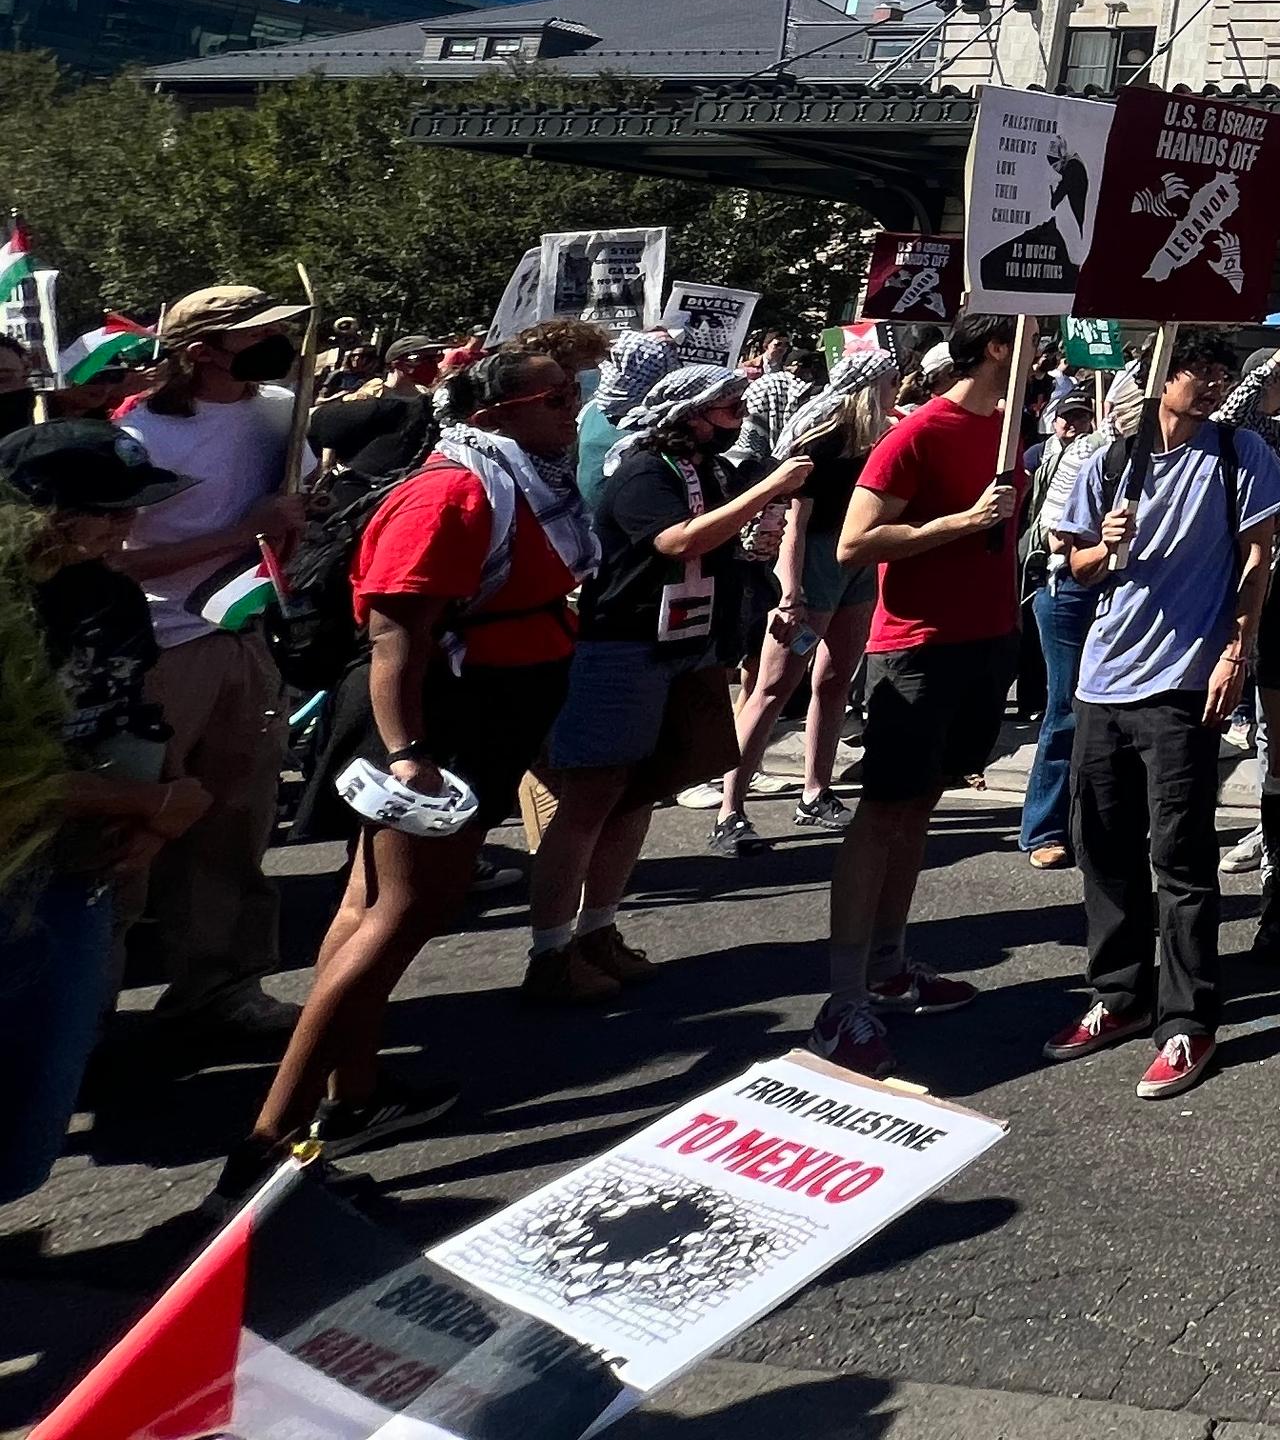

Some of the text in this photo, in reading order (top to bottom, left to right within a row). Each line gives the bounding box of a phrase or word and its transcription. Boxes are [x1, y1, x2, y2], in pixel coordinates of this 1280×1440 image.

[1002, 113, 1058, 134] PALESTINIAN
[1164, 101, 1268, 141] U.S. & ISRAEL
[999, 136, 1037, 155] PARENTS
[1156, 129, 1261, 172] HANDS OFF
[997, 160, 1016, 176] LOVE
[995, 183, 1018, 200] THEIR
[992, 208, 1031, 225] CHILDREN
[1165, 184, 1230, 262] LEBANON
[1012, 242, 1023, 258] AS
[895, 253, 949, 268] HANDS OFF
[1022, 263, 1042, 278] LOVE
[687, 297, 740, 311] DIVEST
[734, 1076, 950, 1153] FROM PALESTINE
[657, 1112, 885, 1204] TO MEXICO
